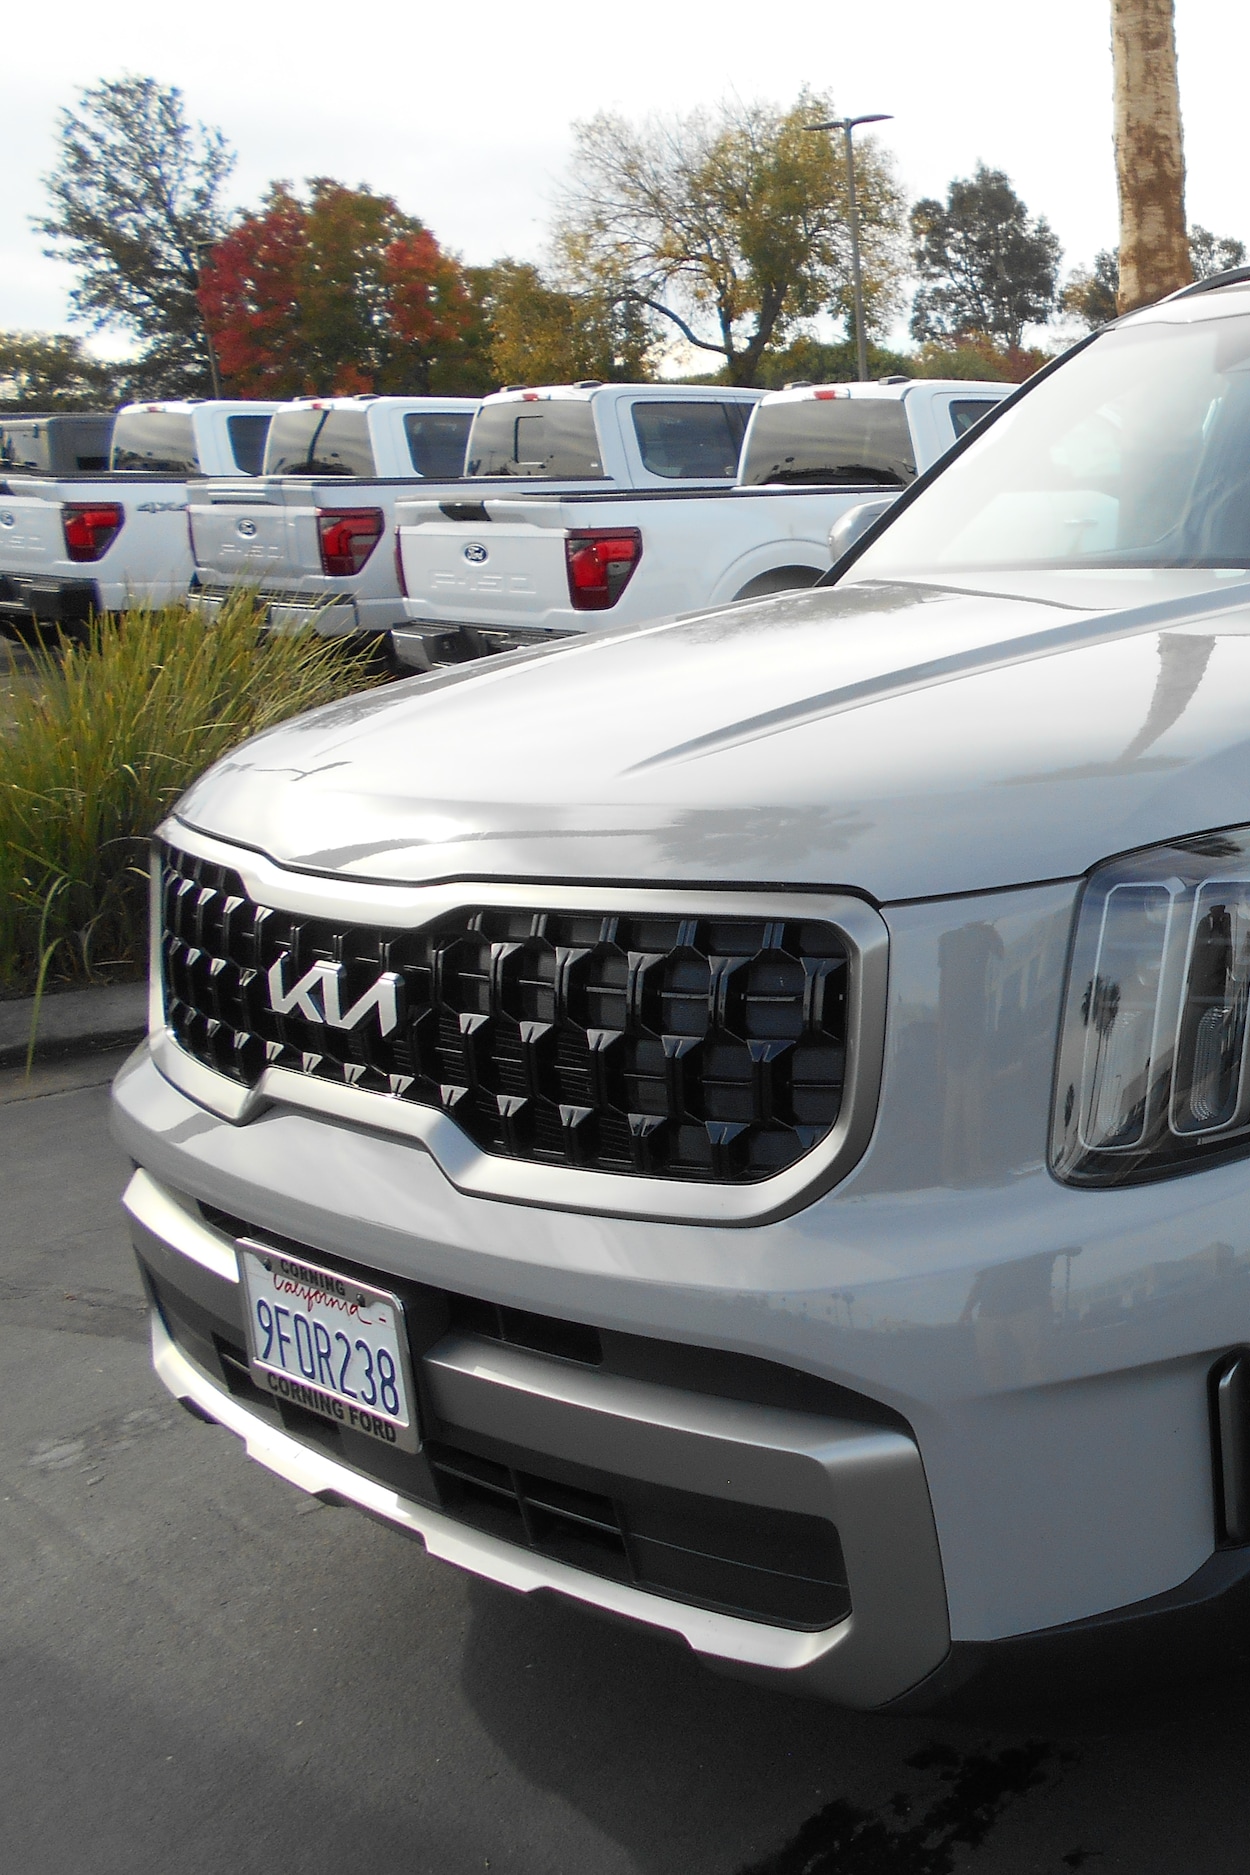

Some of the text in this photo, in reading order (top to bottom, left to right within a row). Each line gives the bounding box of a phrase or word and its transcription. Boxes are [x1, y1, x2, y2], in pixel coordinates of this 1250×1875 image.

[267, 951, 401, 1038] KIA
[280, 1259, 346, 1296] CORNING
[267, 1371, 397, 1443] CORNING FORD
